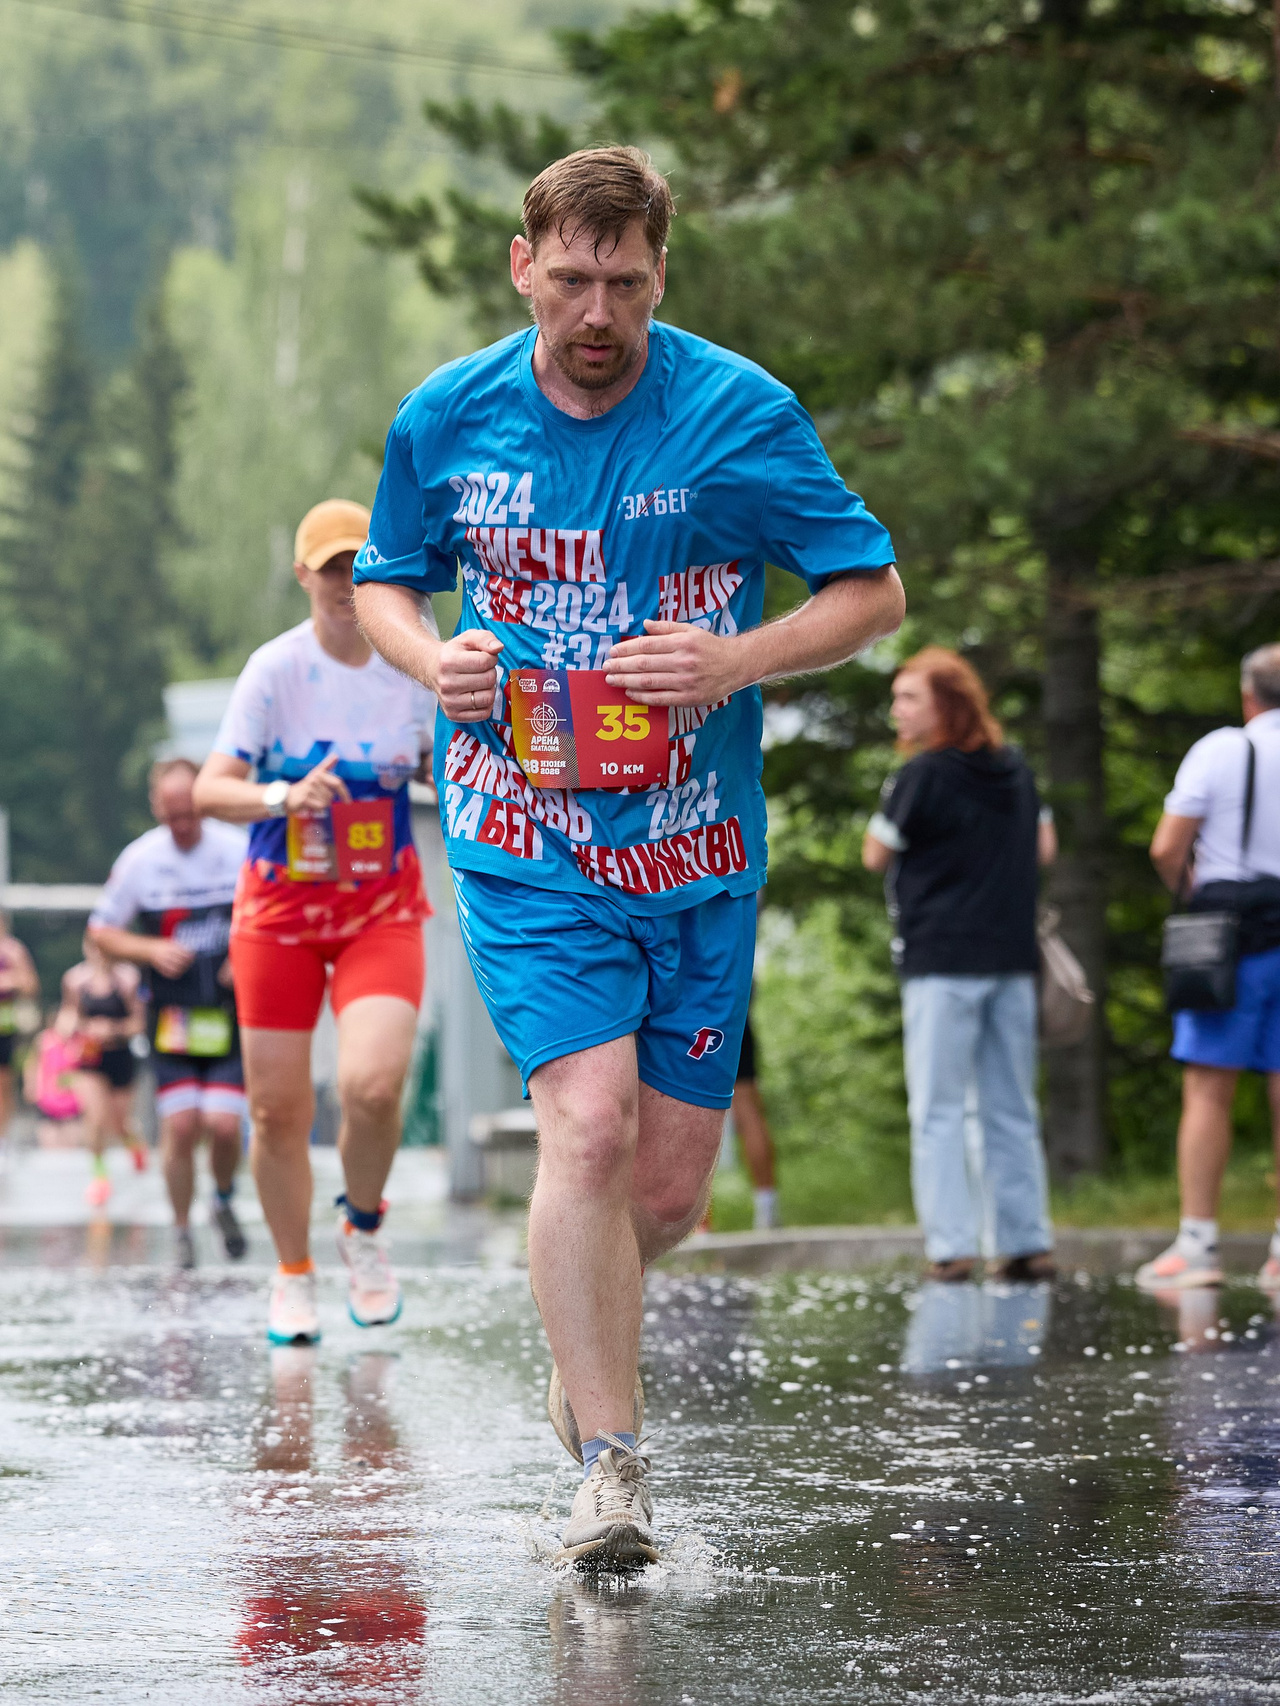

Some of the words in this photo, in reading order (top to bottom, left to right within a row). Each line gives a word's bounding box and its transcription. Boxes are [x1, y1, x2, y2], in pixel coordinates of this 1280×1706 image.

[448, 471, 535, 525] 2024
[531, 581, 635, 634] 2024
[530, 735, 560, 746] АРЕНА
[595, 705, 651, 741] 35
[522, 759, 539, 774] 28
[600, 762, 619, 775] 10
[646, 770, 720, 840] 2024
